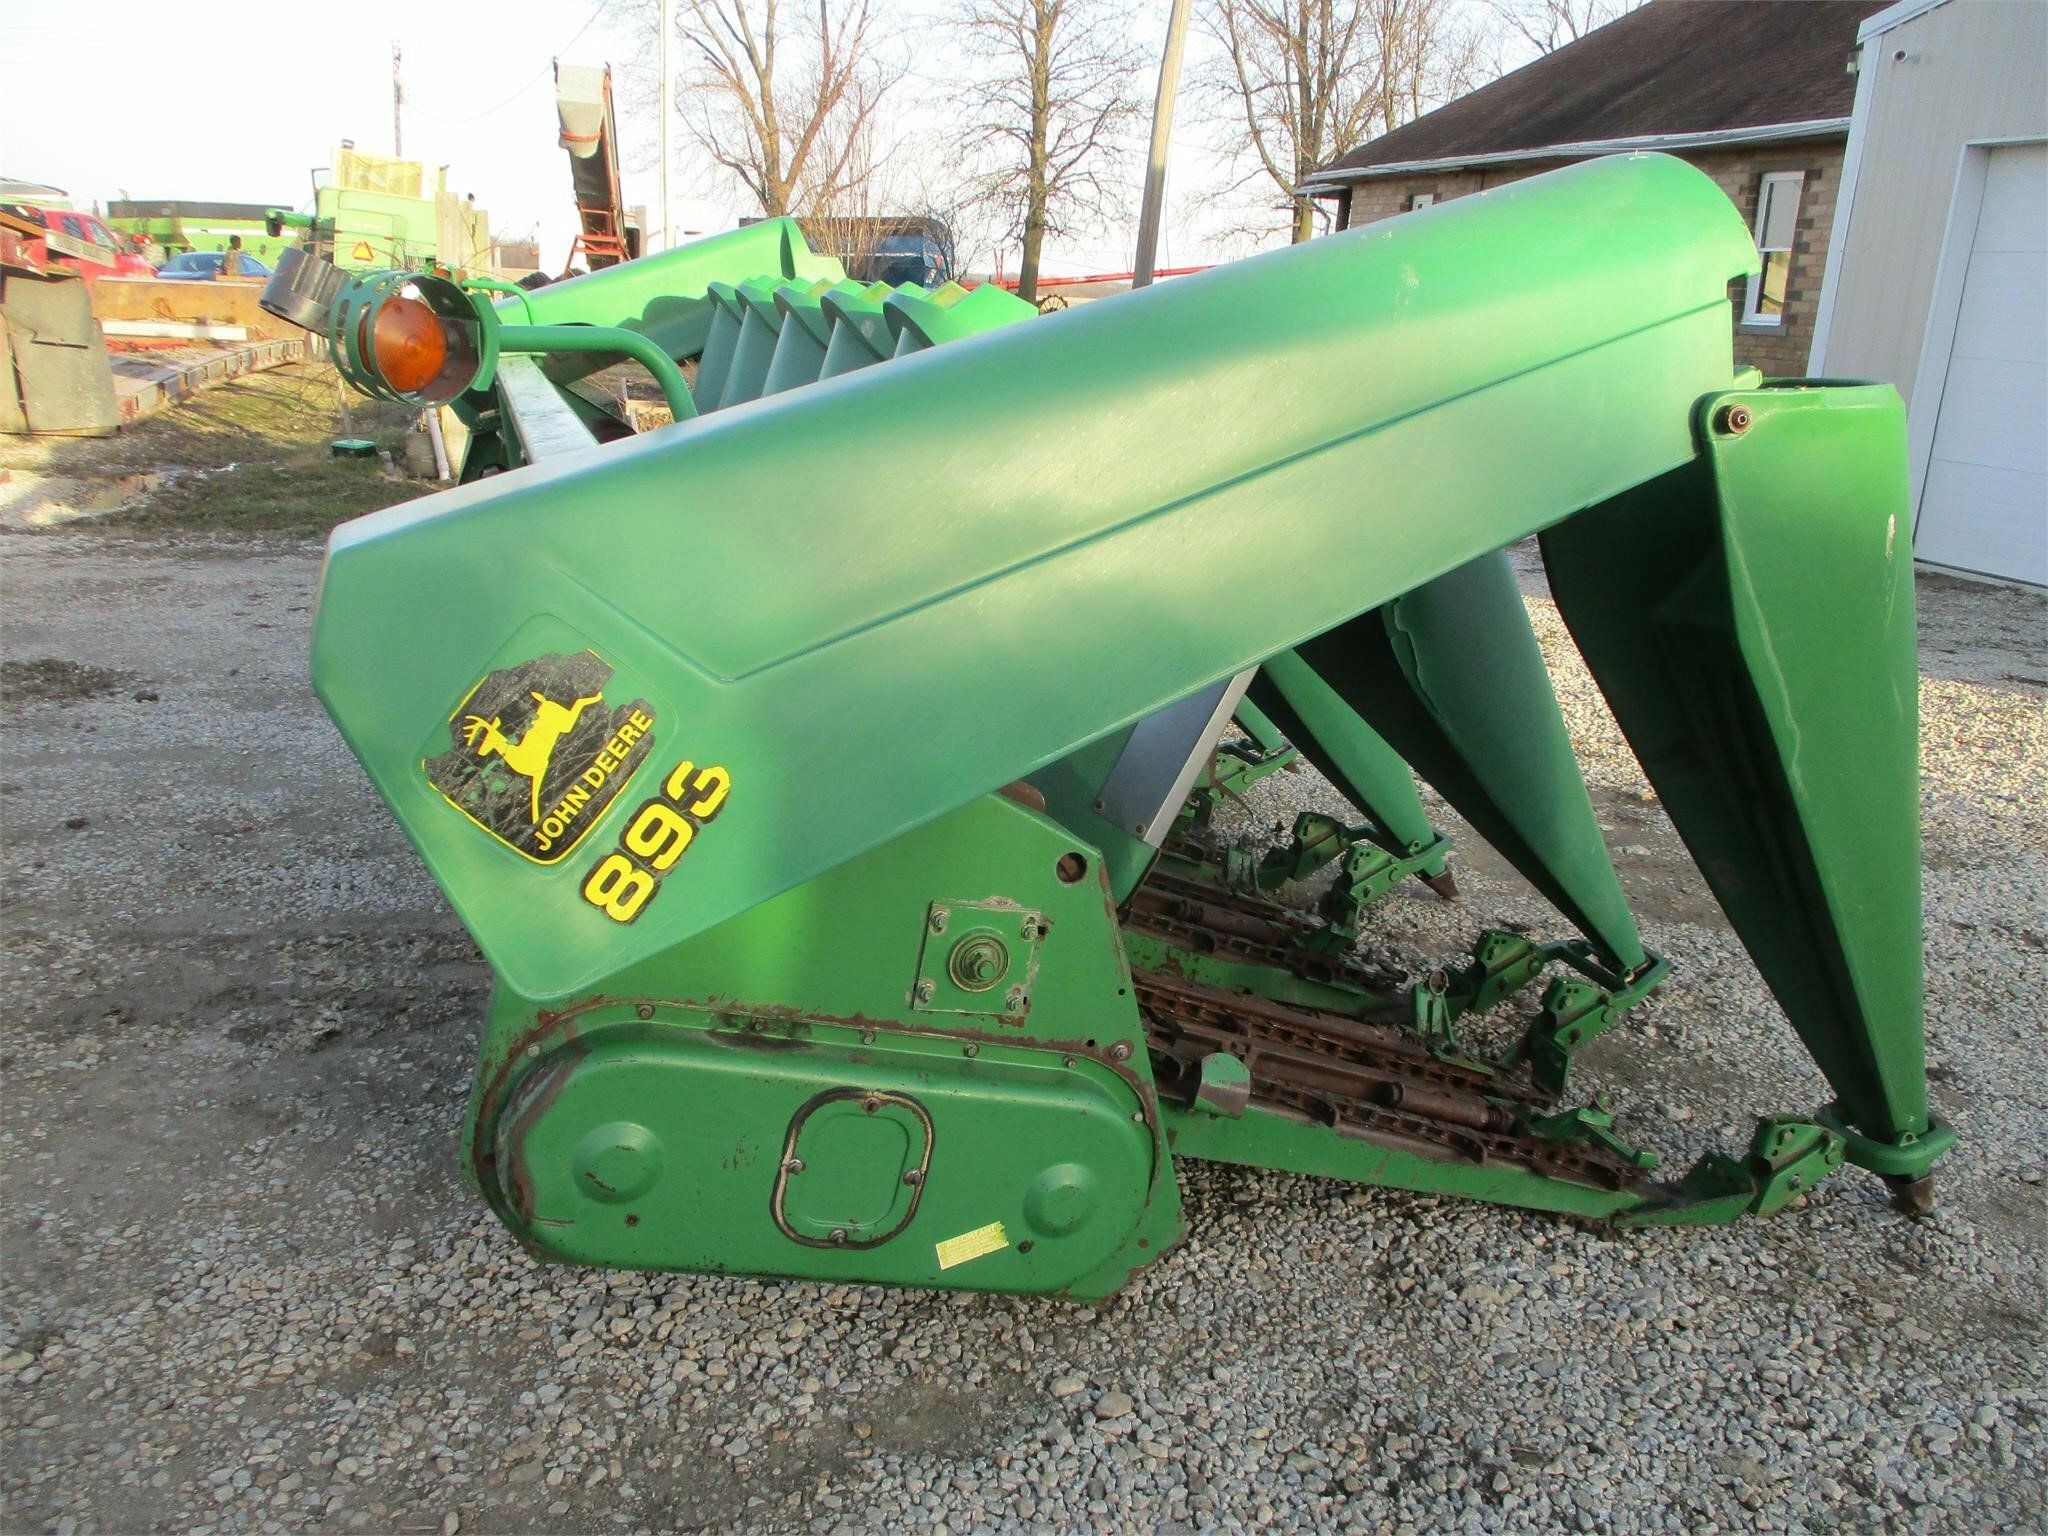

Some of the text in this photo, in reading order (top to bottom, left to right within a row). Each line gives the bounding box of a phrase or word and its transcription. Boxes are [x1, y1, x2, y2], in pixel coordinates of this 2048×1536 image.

[534, 709, 653, 851] JOHN DEERE
[583, 760, 731, 923] 893
